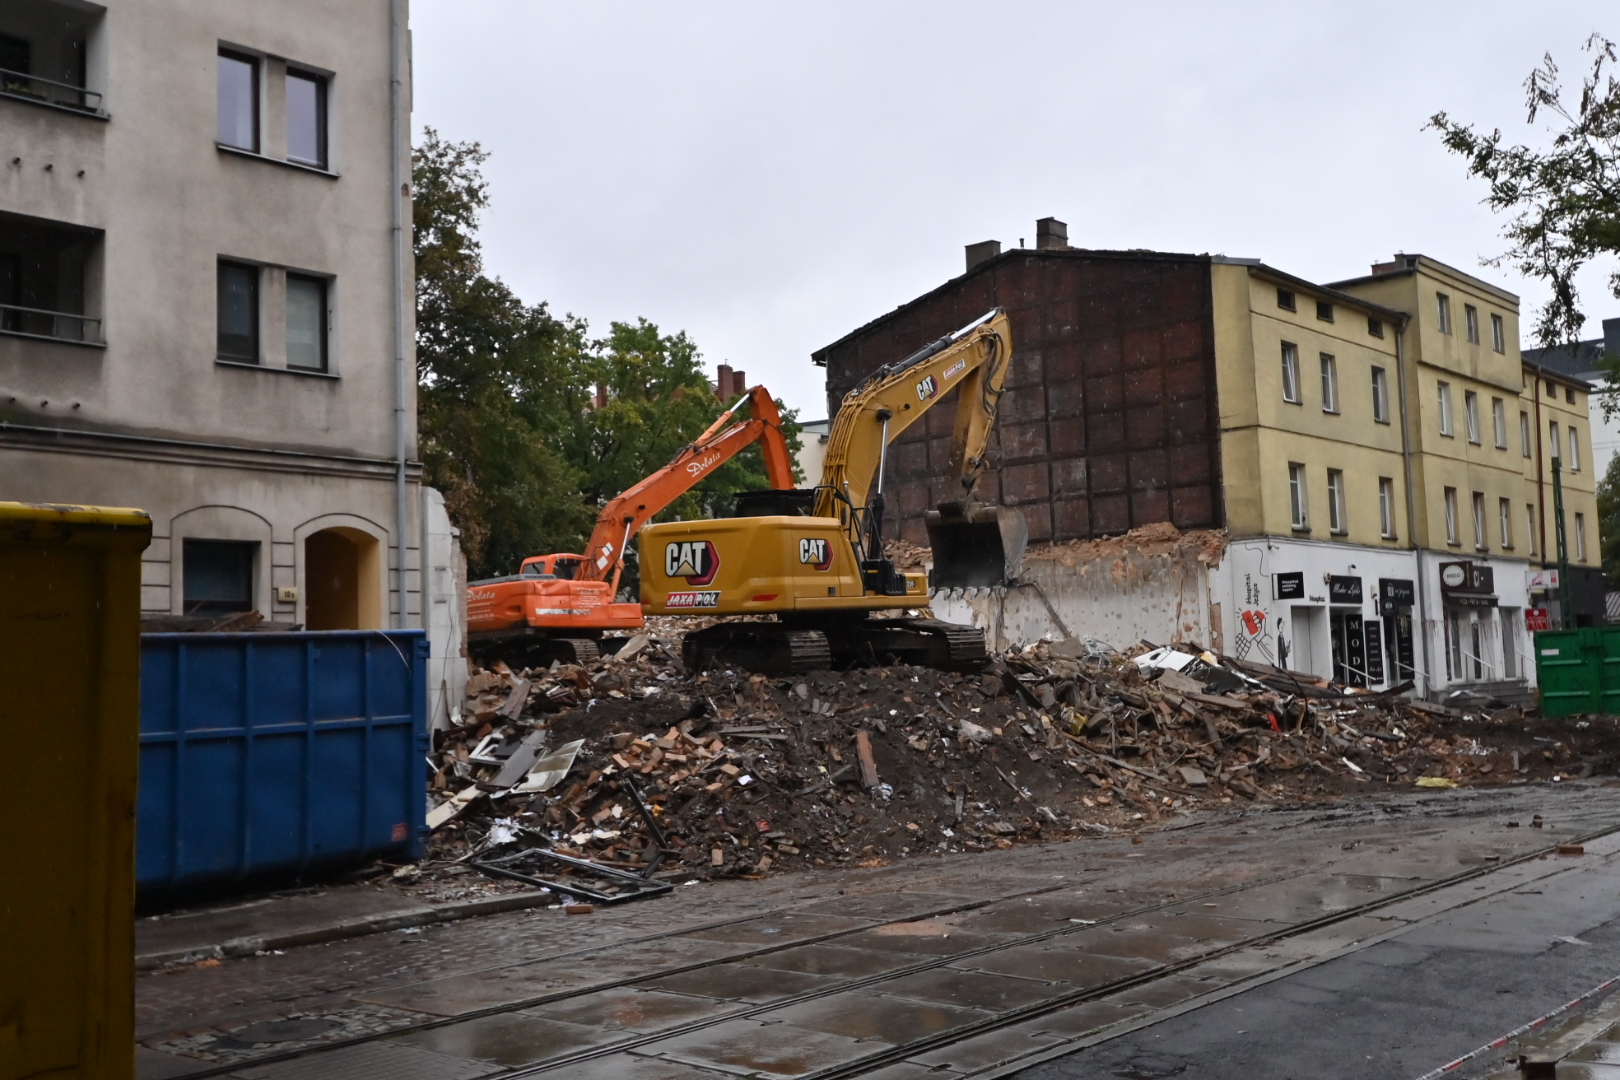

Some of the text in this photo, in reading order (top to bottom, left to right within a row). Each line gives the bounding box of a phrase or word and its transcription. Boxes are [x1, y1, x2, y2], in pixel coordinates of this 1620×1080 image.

[916, 375, 934, 401] CAT
[686, 452, 720, 478] Dolata
[666, 541, 706, 577] CAT
[799, 538, 825, 564] CAT
[1350, 620, 1362, 683] MODA
